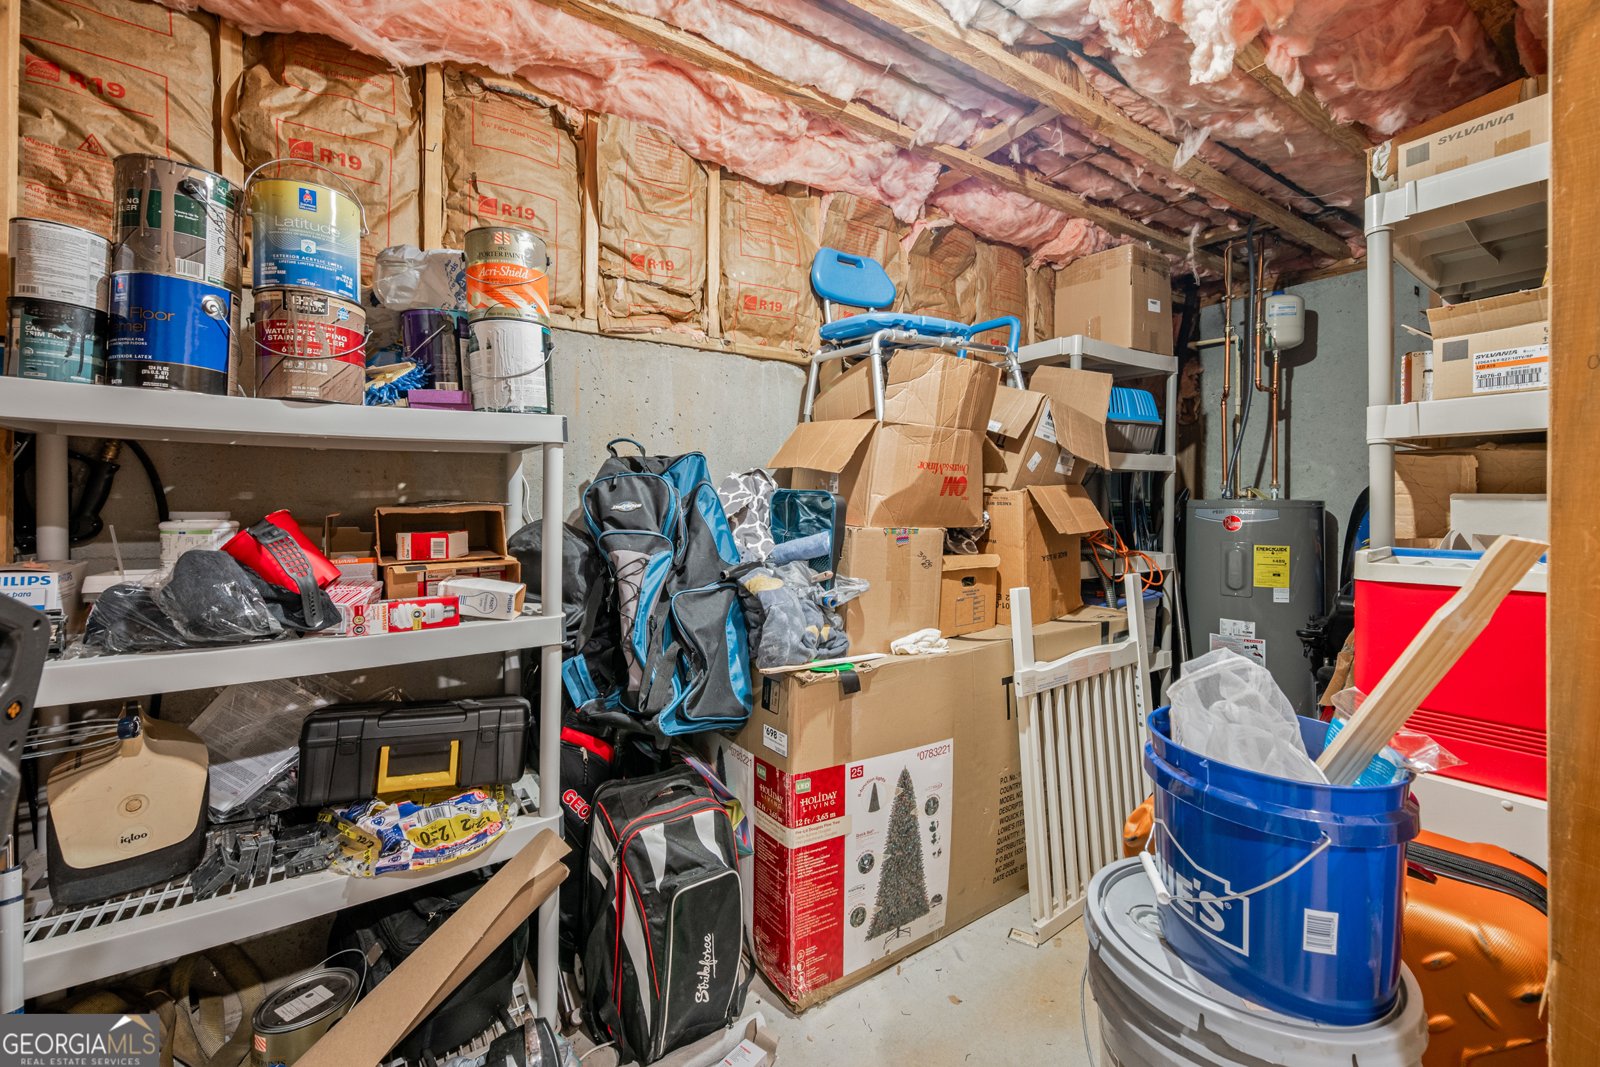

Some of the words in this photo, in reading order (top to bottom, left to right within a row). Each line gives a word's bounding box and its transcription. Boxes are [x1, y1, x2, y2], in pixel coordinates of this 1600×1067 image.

[1437, 112, 1515, 146] SYLVANIA
[501, 203, 536, 220] R-19
[275, 216, 340, 238] Latitude
[647, 258, 674, 271] R-19
[479, 265, 529, 279] Acri-Shield
[130, 306, 176, 321] Floor
[1475, 350, 1518, 360] SYLVANIA
[0, 575, 51, 586] ILIPS
[851, 766, 863, 778] 25
[760, 784, 784, 804] HOLIDAY
[800, 790, 838, 806] HOLIDAY
[1000, 793, 1015, 805] MODEL
[562, 789, 592, 824] GEO
[802, 799, 836, 813] LIVING
[795, 819, 803, 827] 12
[803, 816, 810, 825] ft
[809, 825, 824, 833] Douglas
[120, 831, 148, 844] igloo
[695, 933, 718, 1003] Strikeforce
